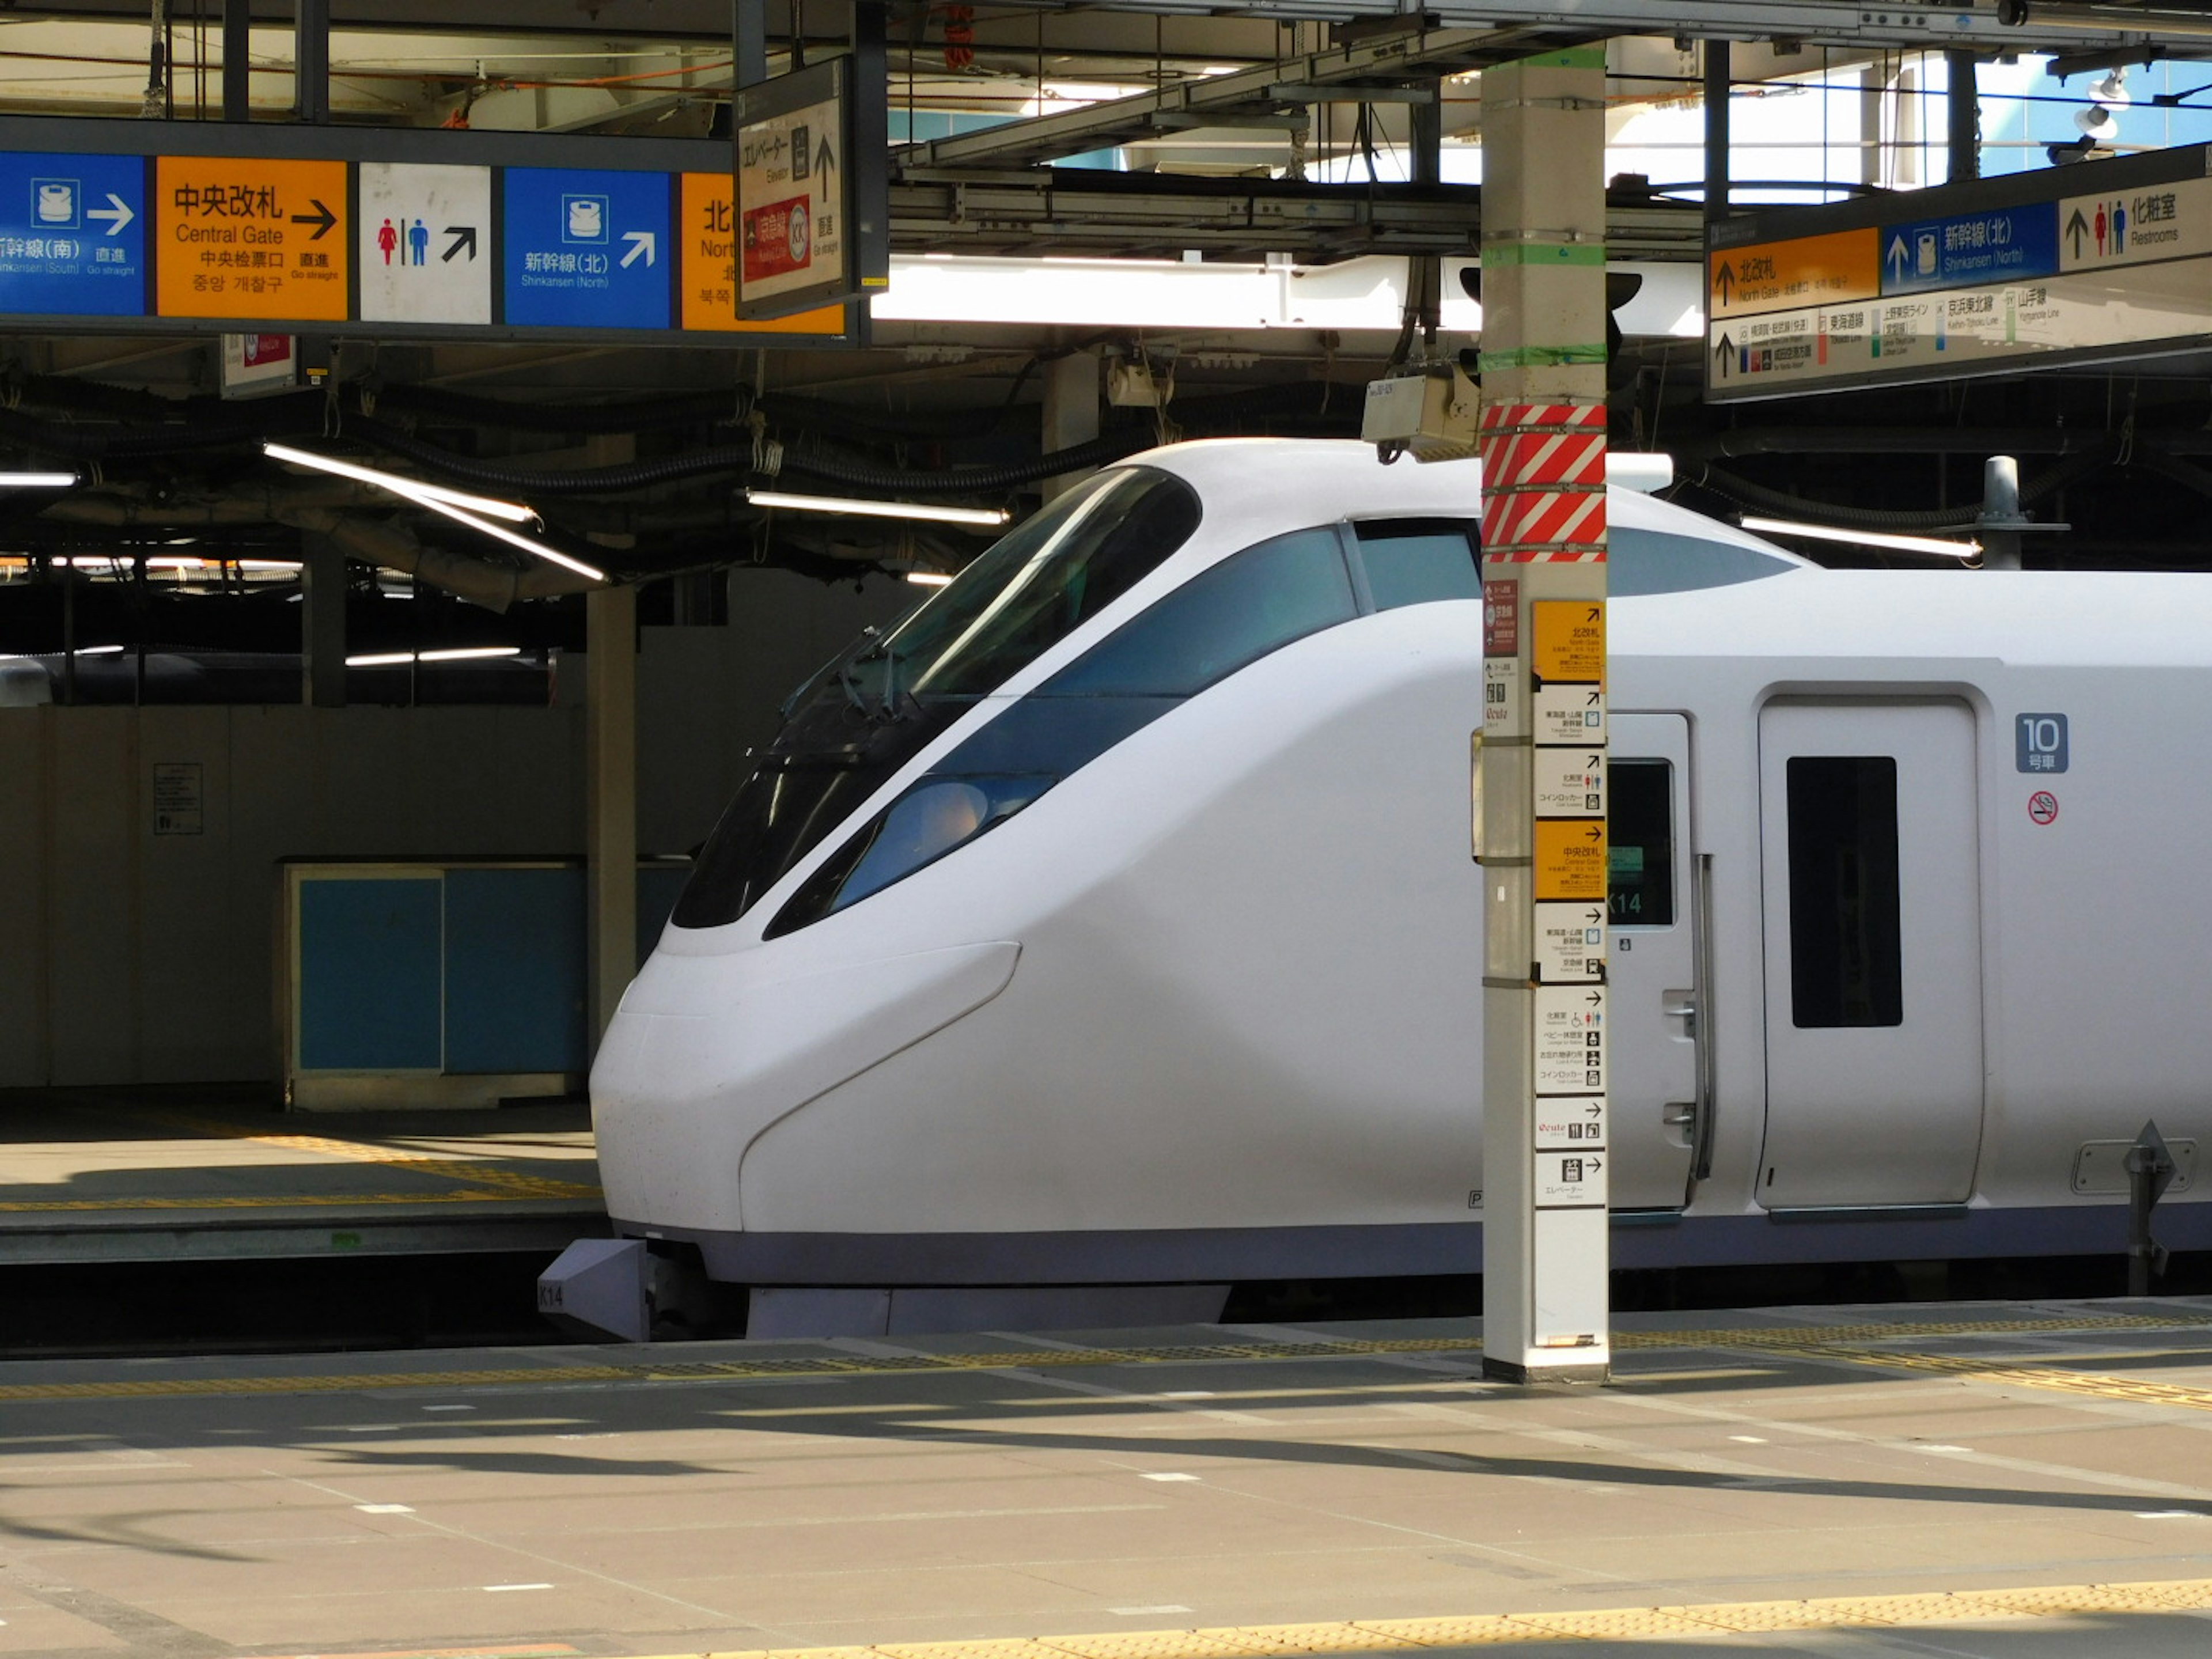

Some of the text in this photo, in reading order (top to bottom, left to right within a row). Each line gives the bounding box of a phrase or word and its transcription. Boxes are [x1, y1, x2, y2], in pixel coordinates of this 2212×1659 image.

[744, 136, 788, 166] エレベーター
[175, 183, 283, 219] 中央改札
[2132, 192, 2176, 225] 化粧室
[704, 199, 734, 233] 北
[176, 224, 283, 244] Central Gate
[1945, 216, 2012, 252] 新幹線(北)
[2132, 229, 2179, 246] Restrooms
[96, 247, 126, 263] 直進
[200, 251, 283, 268] 中央检票口
[300, 253, 329, 267] 直進
[525, 252, 608, 274] 新幹線(北)
[1945, 247, 2024, 272] Shinkansen (North)
[46, 262, 79, 274] (South)
[88, 266, 134, 276] Go straight
[291, 270, 338, 281] Go straight
[1740, 256, 1776, 283] 北改札
[193, 274, 283, 293] 중앙 개찰구
[521, 275, 609, 289] Shinkansen (North)
[1740, 287, 1779, 302] North Gate
[2018, 287, 2047, 308] 山手線
[1883, 304, 1928, 321] 上野東京ライン
[1948, 295, 1993, 317] 京浜東北線
[1831, 312, 1864, 331] 東海道線
[1573, 628, 1600, 638] 北改札
[2023, 718, 2059, 752] 10
[2029, 754, 2055, 770] 号車
[1563, 847, 1601, 857] 中央改札
[1545, 1186, 1583, 1194] エレベーター
[539, 1285, 563, 1306] K14
